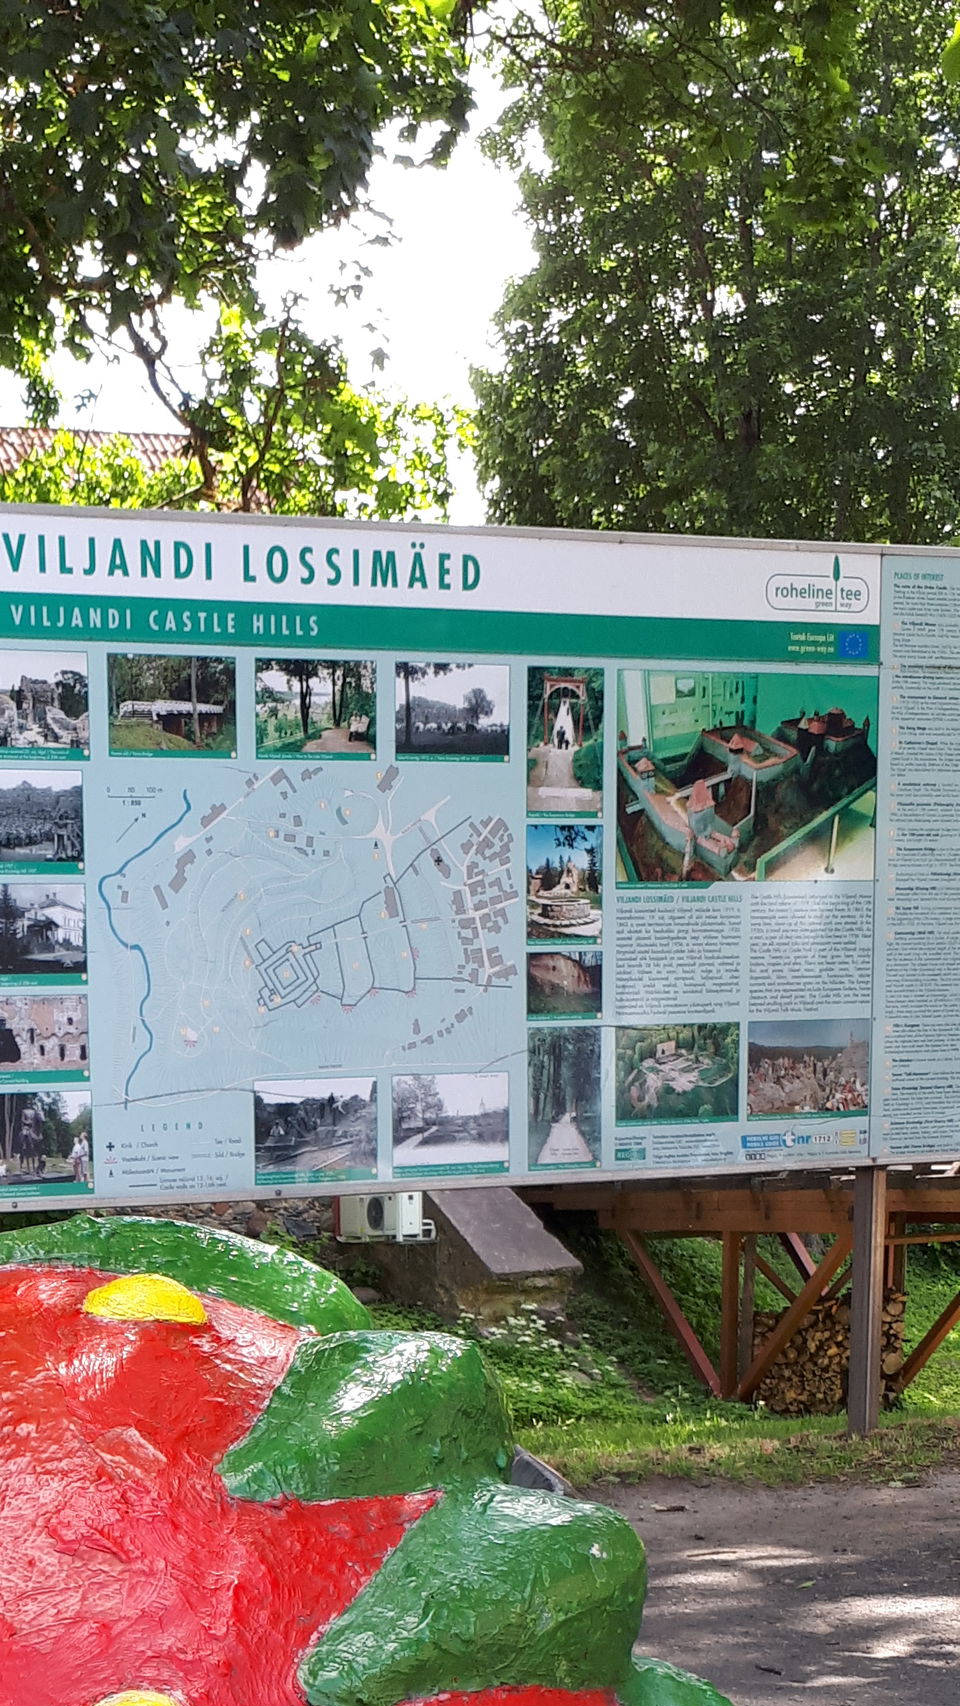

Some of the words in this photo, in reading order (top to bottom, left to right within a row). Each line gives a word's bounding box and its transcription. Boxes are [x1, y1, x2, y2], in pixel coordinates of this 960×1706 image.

[3, 532, 214, 579] VILJANDI
[244, 541, 481, 593] LOSSIMÄED
[775, 582, 833, 599] roheline
[840, 587, 862, 601] tee
[11, 603, 133, 629] VILJANDI
[149, 610, 238, 634] CASTLE
[251, 613, 319, 637] HILLS
